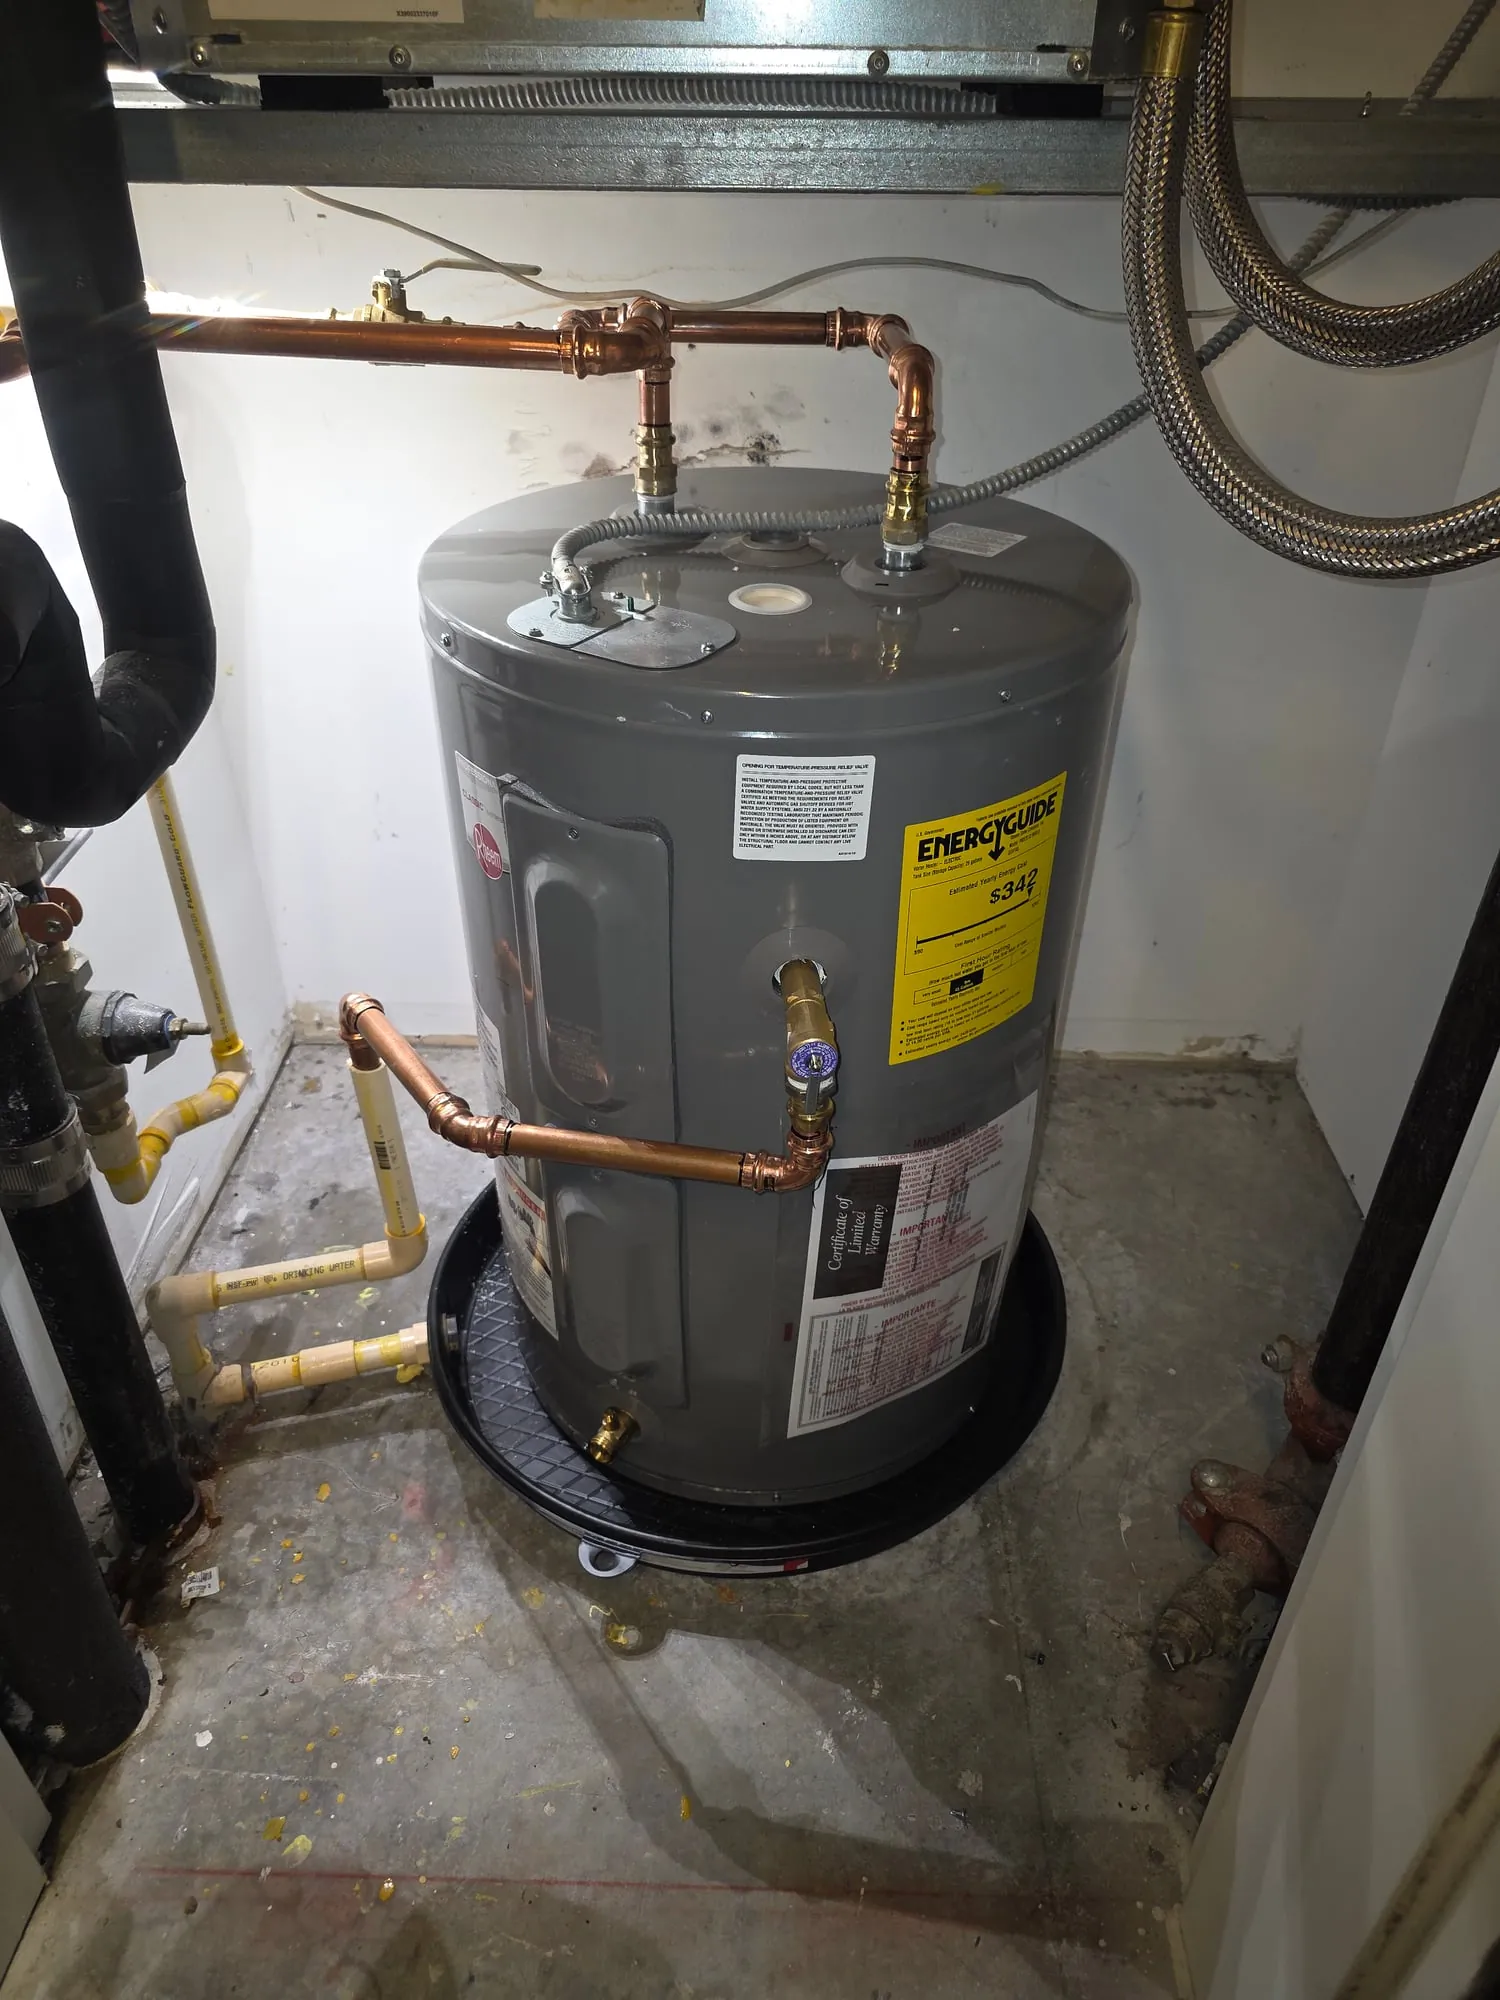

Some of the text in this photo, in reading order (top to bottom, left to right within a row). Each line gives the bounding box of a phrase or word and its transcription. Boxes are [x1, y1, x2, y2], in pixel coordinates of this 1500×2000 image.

[164, 814, 176, 841] GOLD
[474, 824, 502, 868] Rheem
[918, 791, 1058, 862] ENERGYGUIDE
[174, 848, 194, 909] FLOWGUARD
[950, 880, 978, 895] Estimated
[980, 874, 996, 886] Yearly
[999, 867, 1016, 879] Energy
[990, 868, 1038, 904] $342
[961, 958, 975, 969] First
[976, 952, 992, 962] Hour
[993, 944, 1011, 955] Rating
[828, 1194, 853, 1270] Certificate of
[848, 1210, 866, 1254] Limited
[865, 1204, 888, 1255] Warranty
[283, 1265, 324, 1280] DRINKING
[329, 1260, 355, 1272] WATER
[881, 1300, 936, 1328] IMPORTANTE
